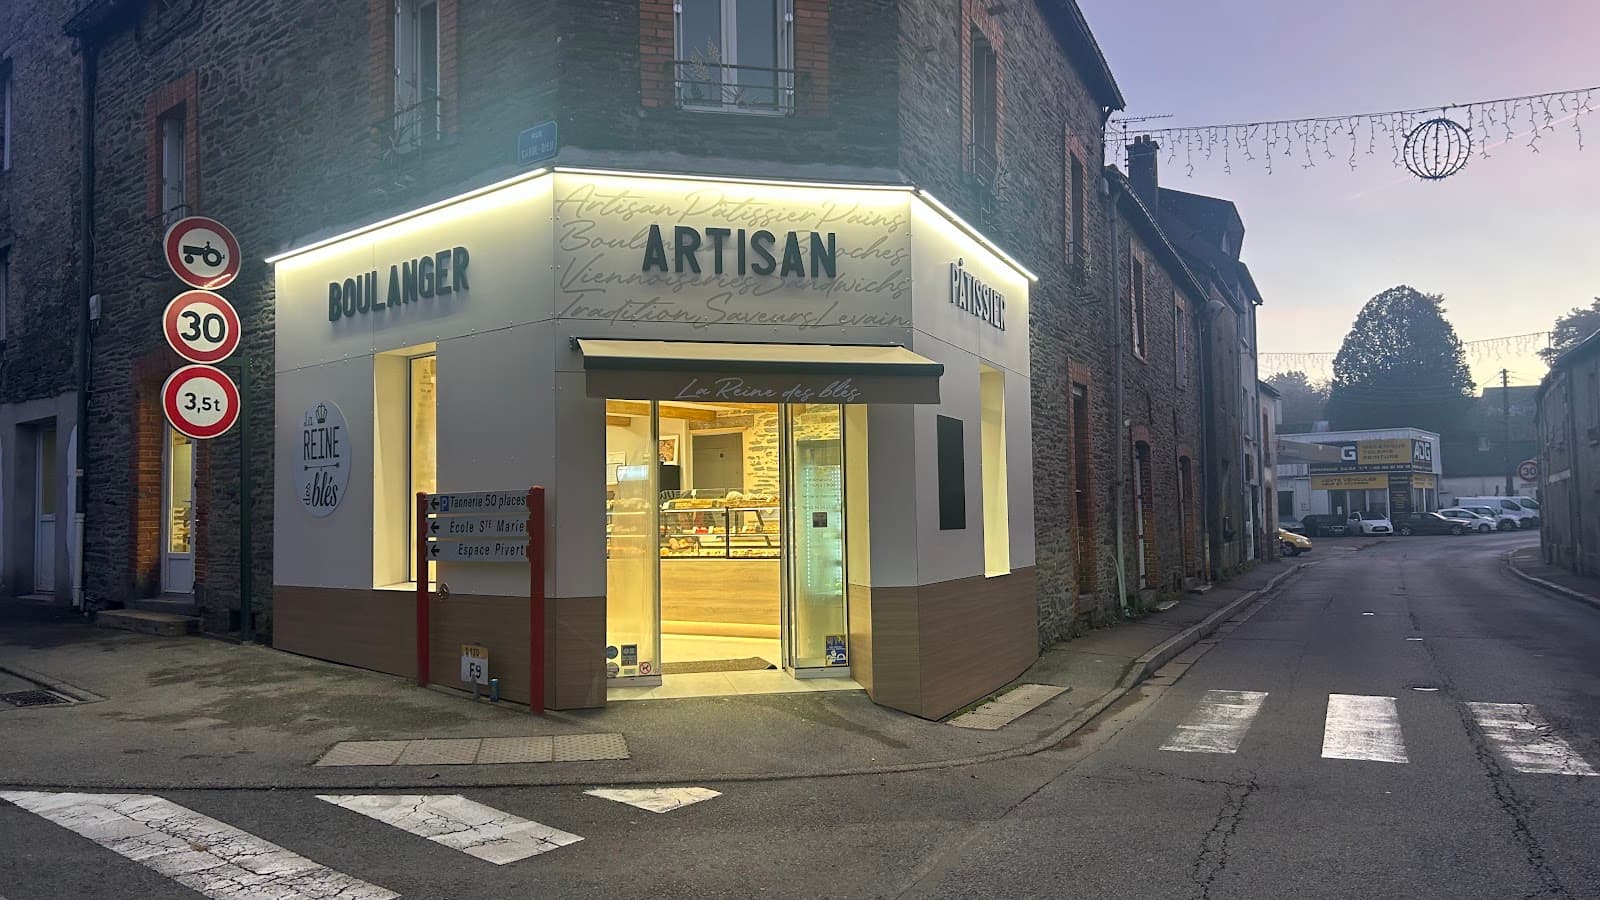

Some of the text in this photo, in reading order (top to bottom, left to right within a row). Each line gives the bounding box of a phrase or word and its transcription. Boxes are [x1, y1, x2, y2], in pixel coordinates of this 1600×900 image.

[556, 183, 679, 221] Artisan
[814, 200, 907, 233] Pains
[641, 224, 837, 278] ARTISAN
[328, 246, 470, 322] BOULANGER
[181, 310, 226, 343] 30
[674, 377, 862, 402] La Reine des blés
[303, 426, 341, 460] REINE
[1523, 467, 1537, 476] 30
[312, 471, 339, 507] blés
[450, 496, 483, 508] Tannerie
[484, 494, 497, 507] 50
[498, 494, 526, 509] places
[496, 519, 524, 533] Marie
[458, 543, 524, 558] Espace Pivert
[469, 662, 481, 679] F9
